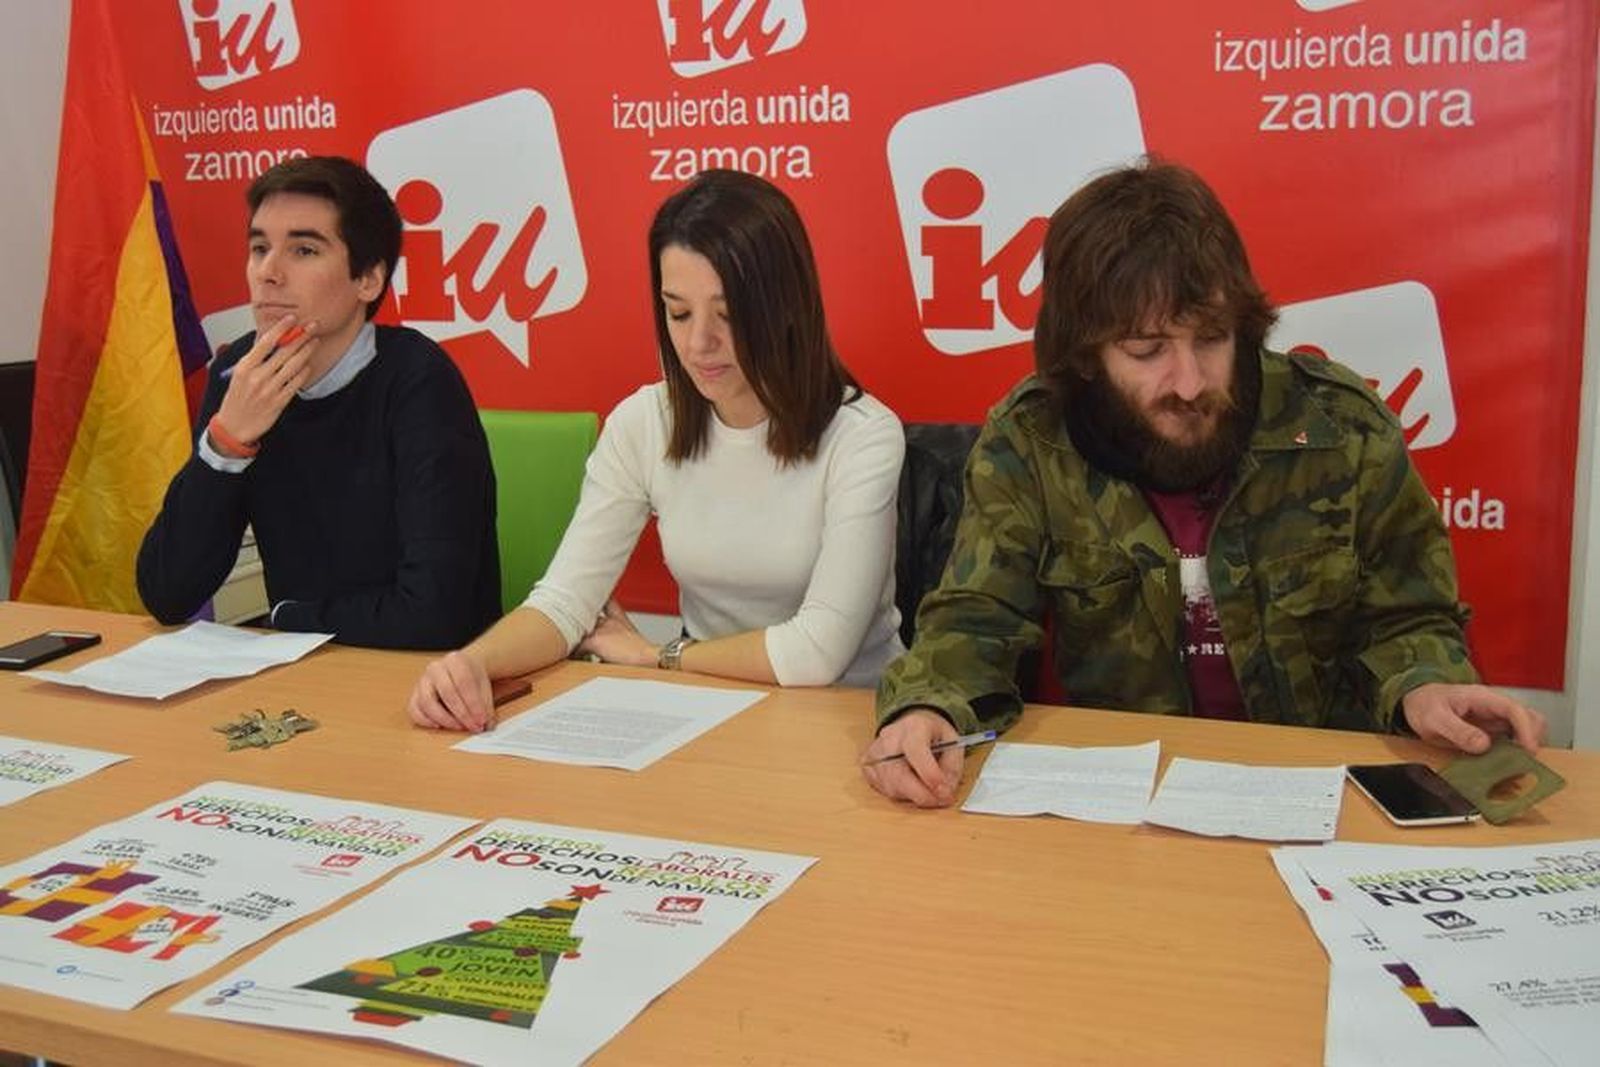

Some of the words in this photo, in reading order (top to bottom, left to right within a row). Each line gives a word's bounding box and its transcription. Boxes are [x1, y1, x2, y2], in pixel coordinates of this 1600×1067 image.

[1214, 25, 1392, 80] izquierda
[1404, 19, 1528, 66] unida
[153, 99, 259, 143] izquierda
[264, 96, 337, 130] unida
[612, 90, 749, 136] izquierda
[756, 86, 851, 125] unida
[1259, 88, 1475, 131] zamora
[184, 148, 308, 181] zamor
[649, 144, 813, 181] zamora
[156, 806, 230, 825] NO
[218, 821, 286, 838] SON
[182, 801, 312, 825] DERECHOS
[452, 844, 541, 866] NO
[533, 860, 616, 881] SON
[646, 879, 762, 899] NAVIDAD
[474, 836, 637, 865] DERECHOS
[636, 860, 775, 884] LABORALES
[1357, 869, 1531, 892] DERECHOS
[1368, 887, 1465, 907] NO
[1466, 884, 1550, 901] SON
[451, 961, 540, 978] JOVEN
